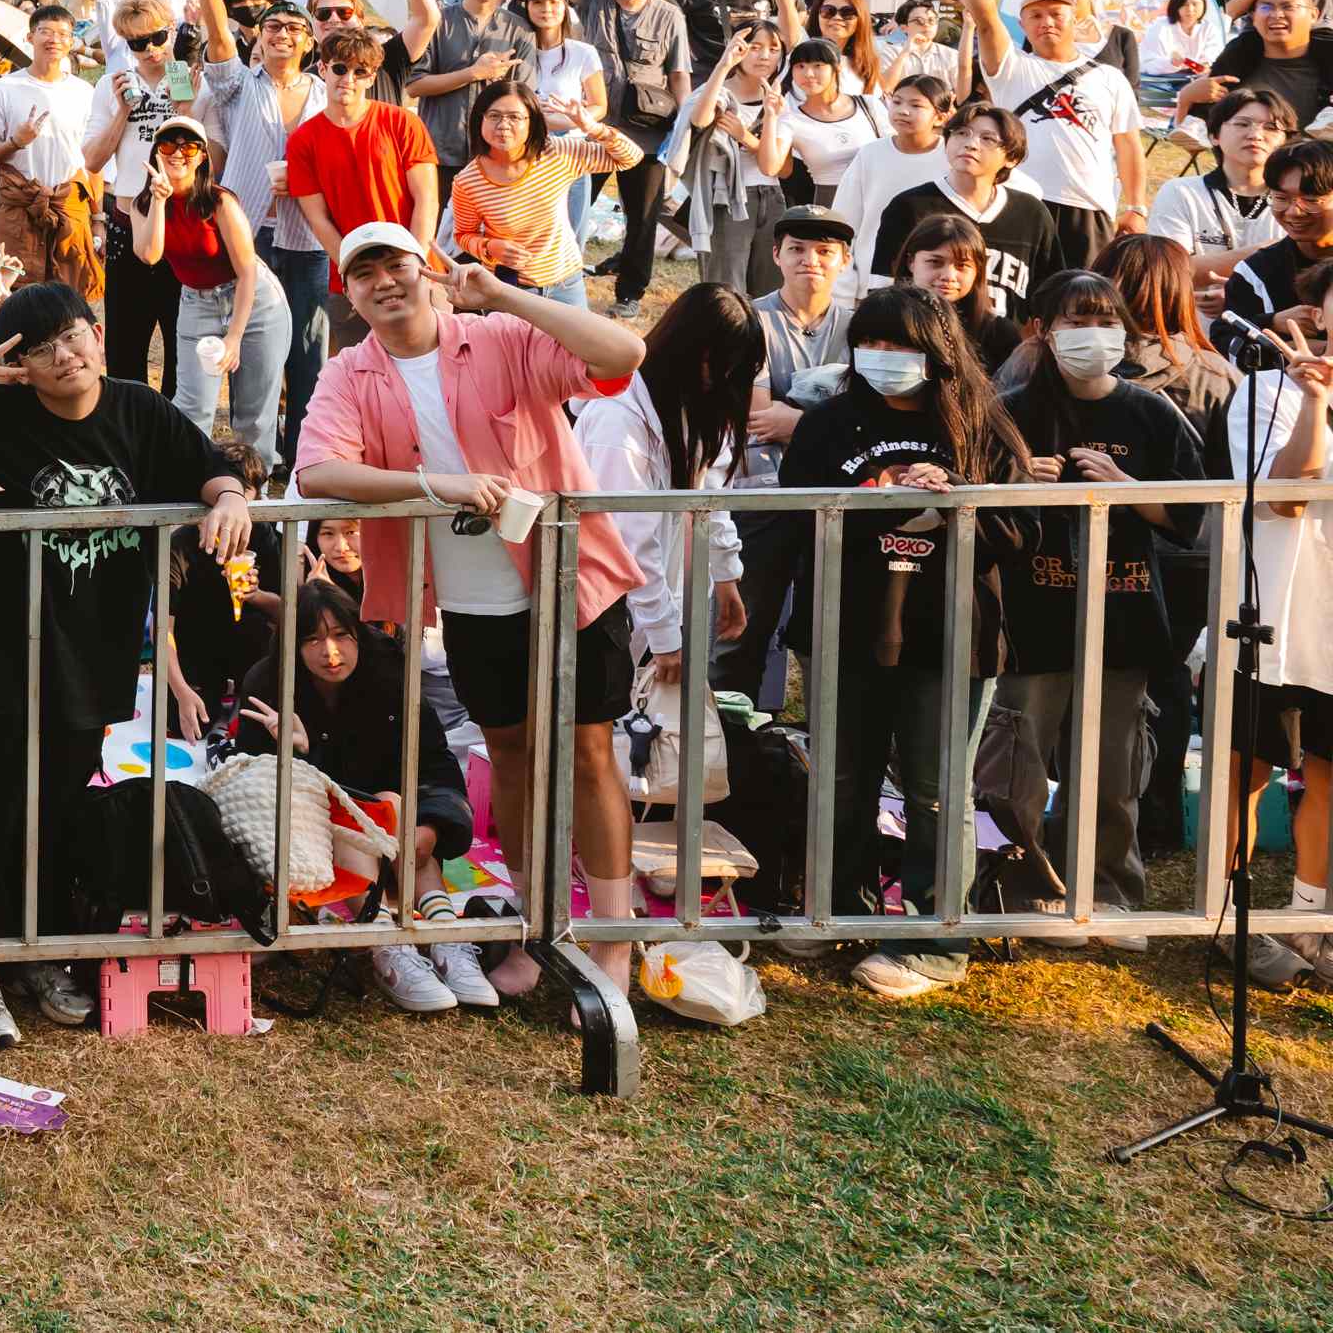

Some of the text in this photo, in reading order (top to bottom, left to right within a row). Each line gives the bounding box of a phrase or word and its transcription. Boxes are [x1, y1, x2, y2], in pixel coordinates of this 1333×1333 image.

[1111, 443, 1129, 456] TO
[1032, 555, 1062, 572] OR
[1033, 571, 1151, 593] GET GRY
